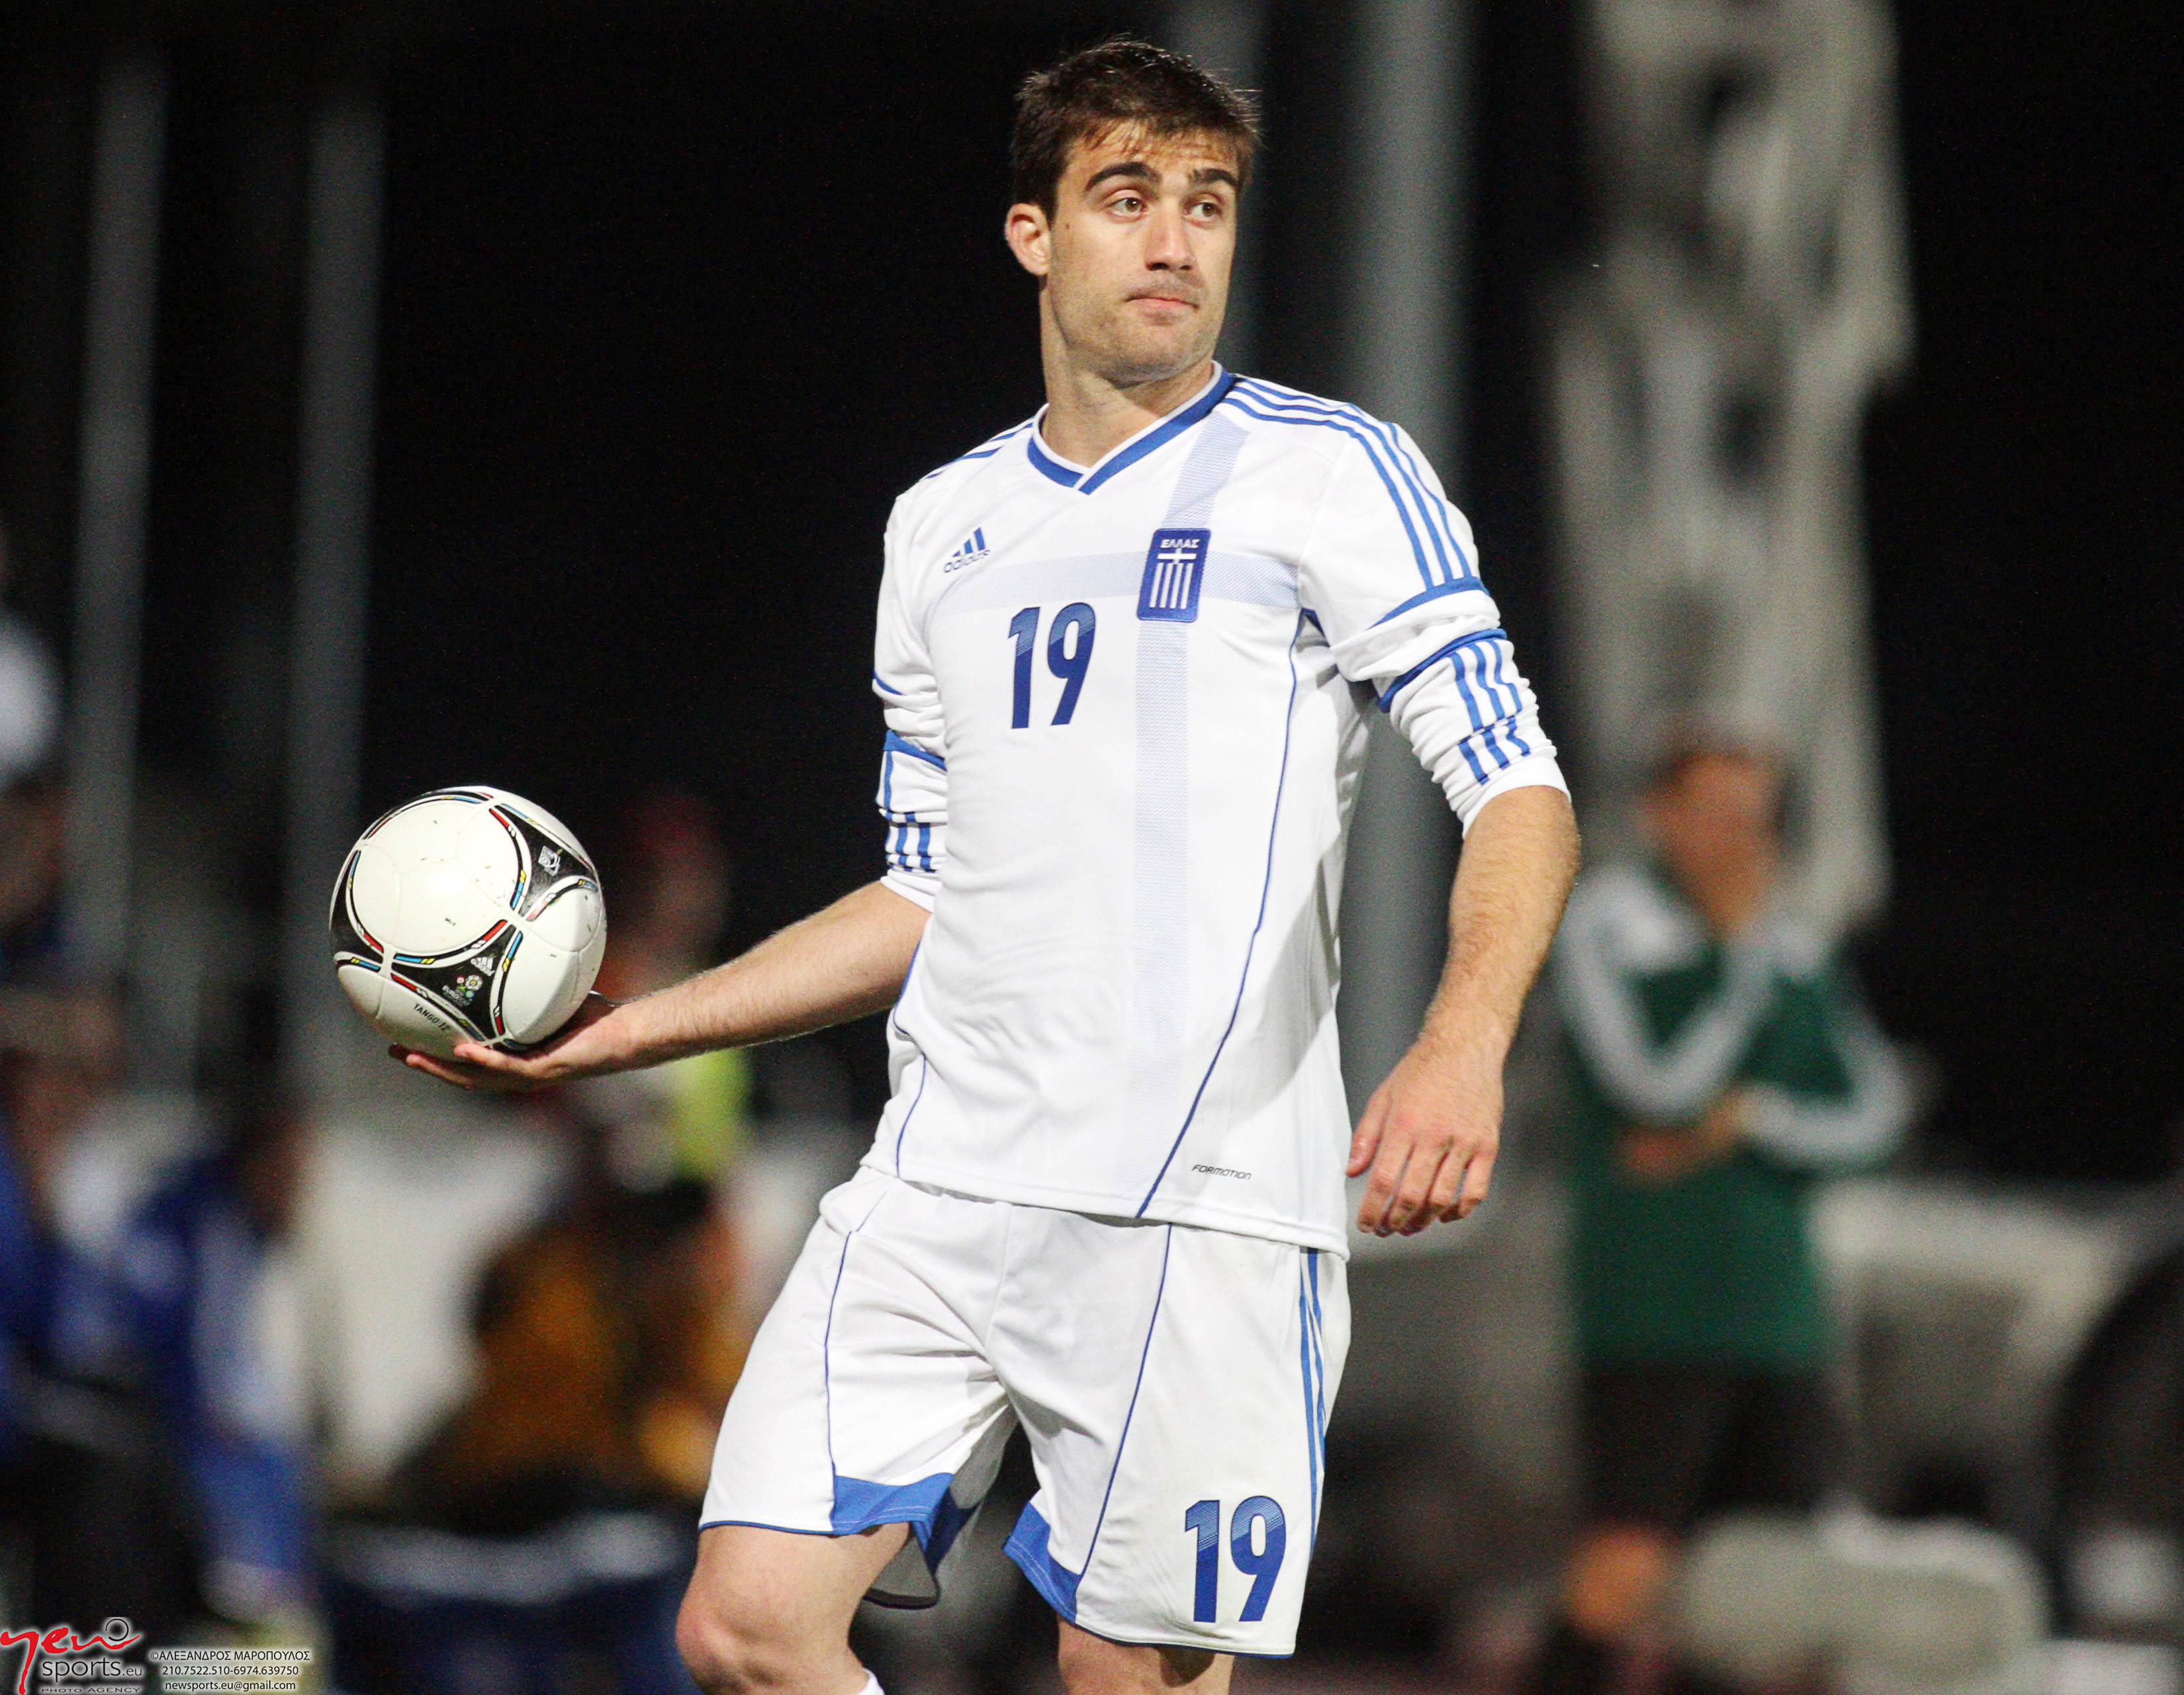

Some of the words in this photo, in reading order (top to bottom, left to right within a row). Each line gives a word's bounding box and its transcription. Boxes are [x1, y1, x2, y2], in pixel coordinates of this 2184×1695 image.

[1008, 602, 1095, 729] 19
[414, 1003, 440, 1023] TANGO
[1185, 1495, 1286, 1623] 19
